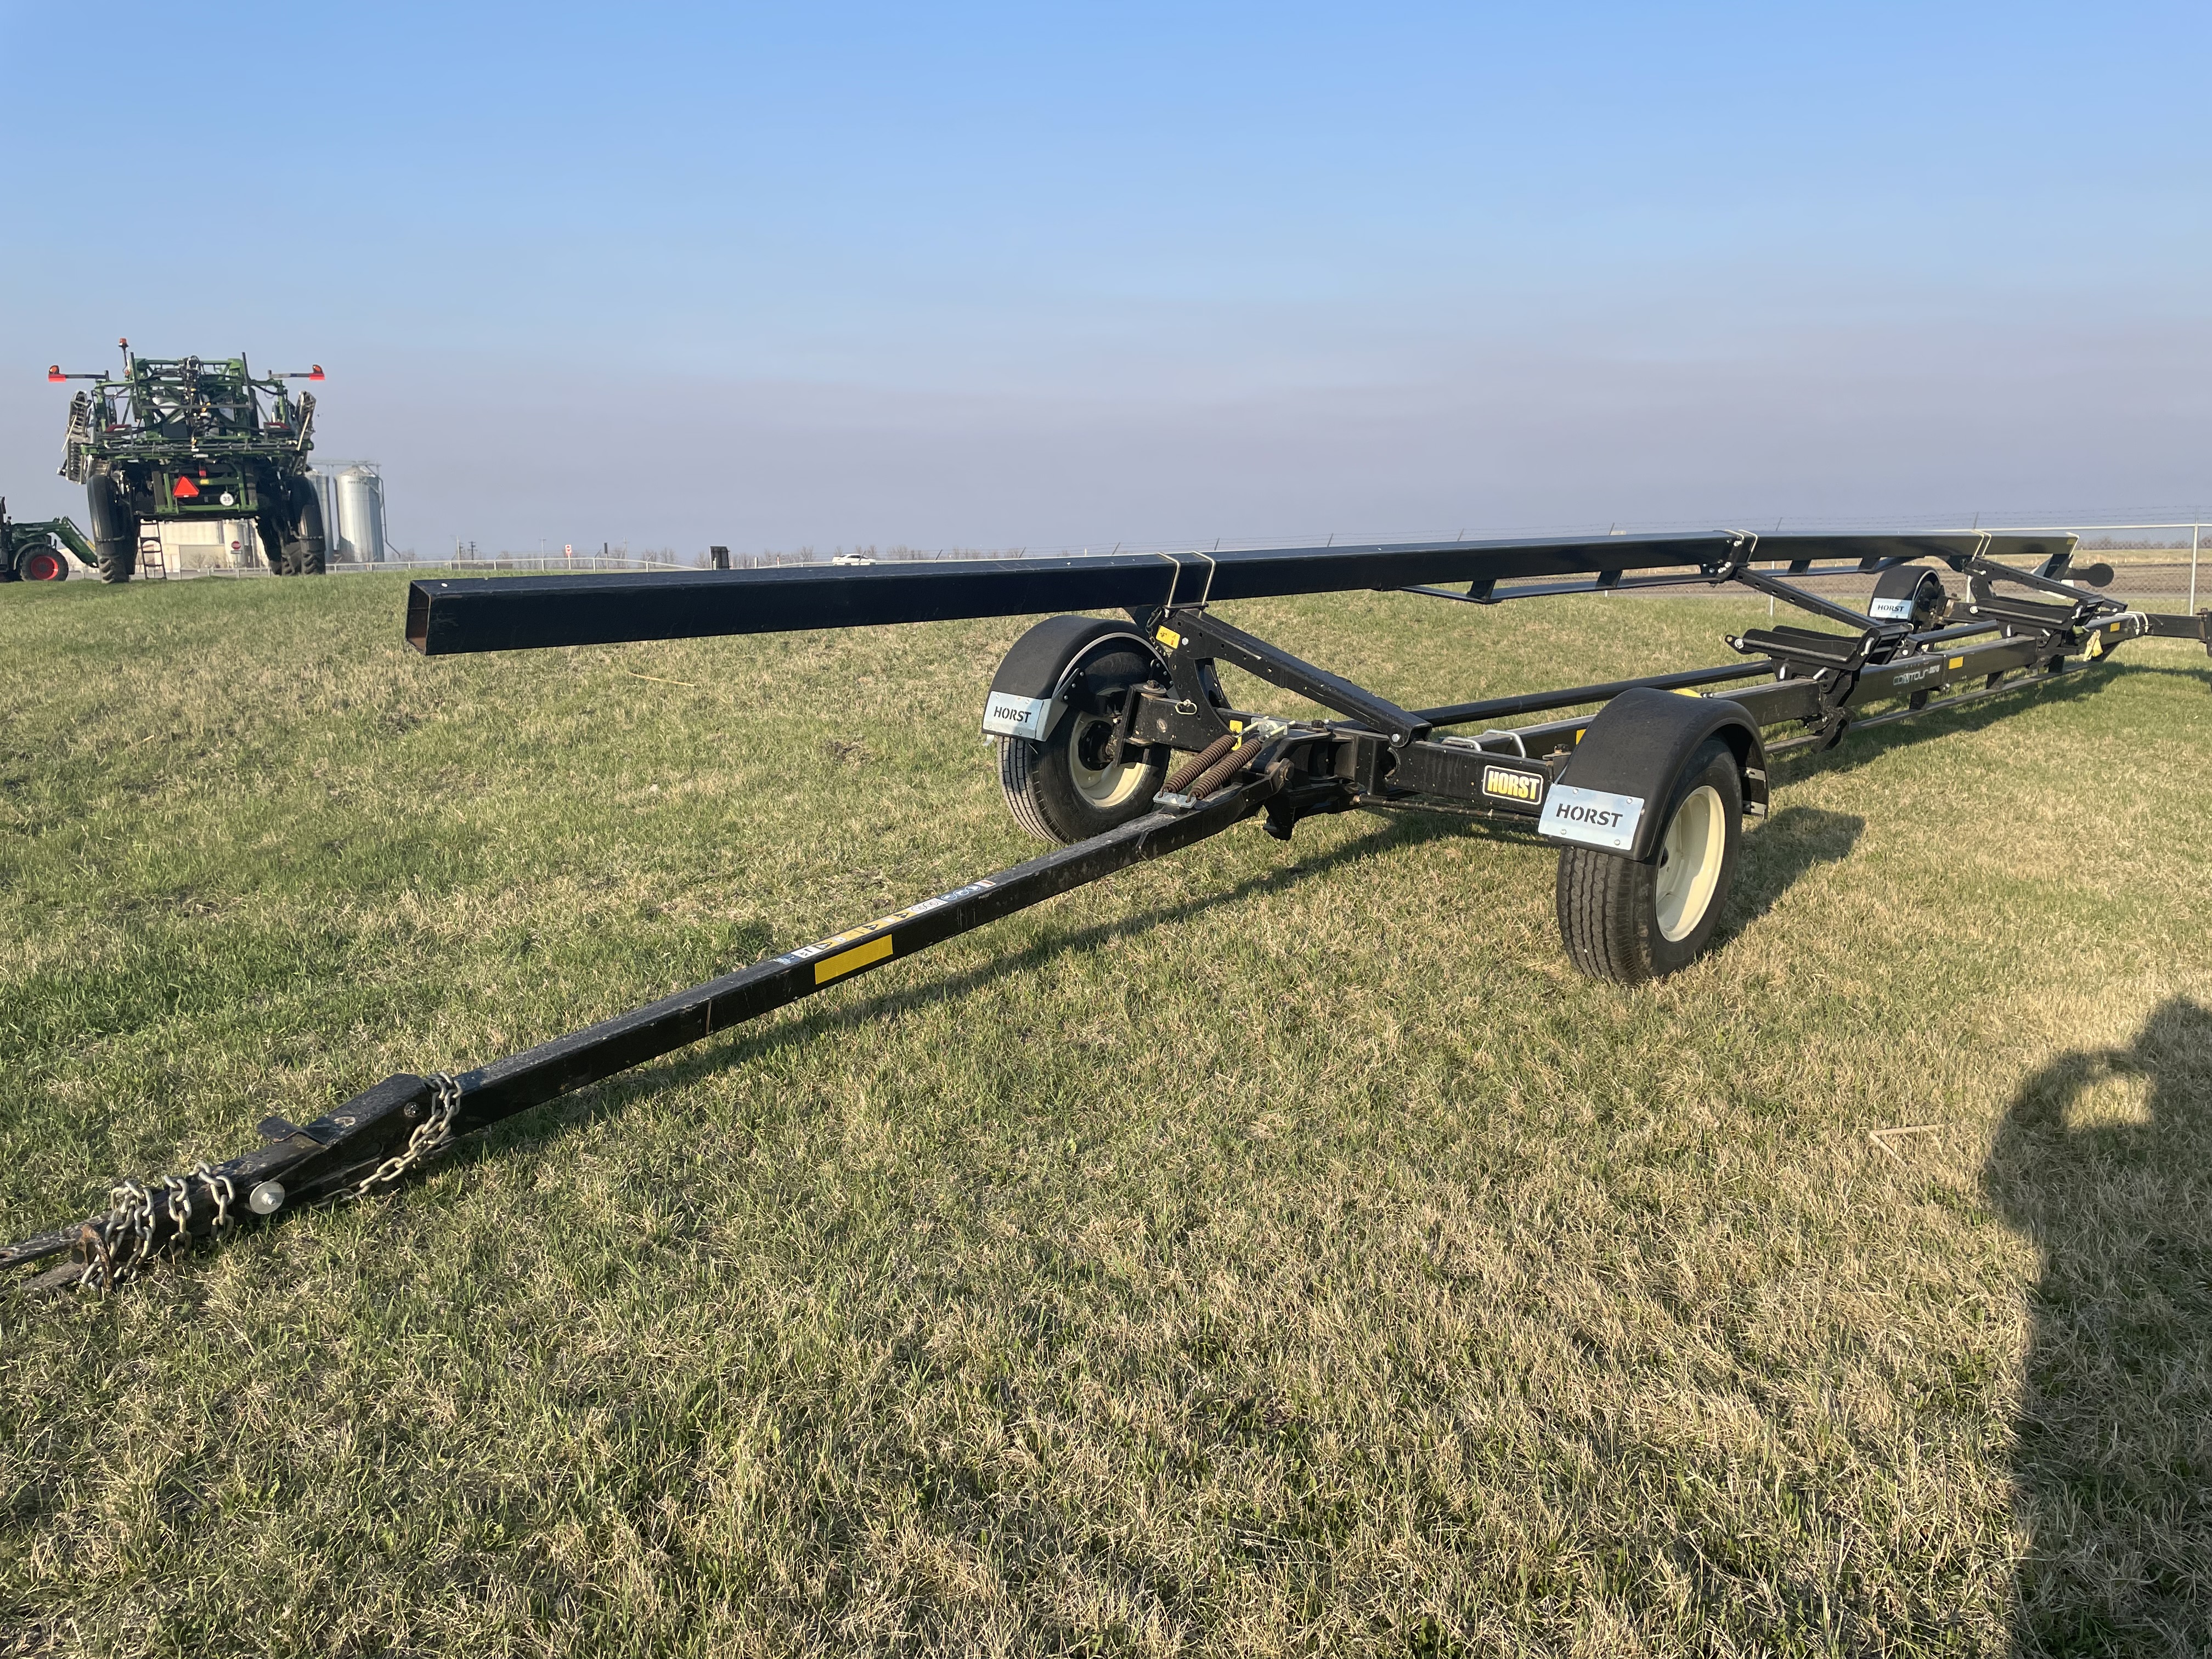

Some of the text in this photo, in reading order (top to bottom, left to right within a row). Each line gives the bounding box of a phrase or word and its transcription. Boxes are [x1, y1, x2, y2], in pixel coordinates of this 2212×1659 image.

[1877, 604, 1905, 612] HORST
[994, 706, 1032, 723] HORST
[1487, 770, 1540, 800] HORST
[1556, 803, 1623, 828] HORST
